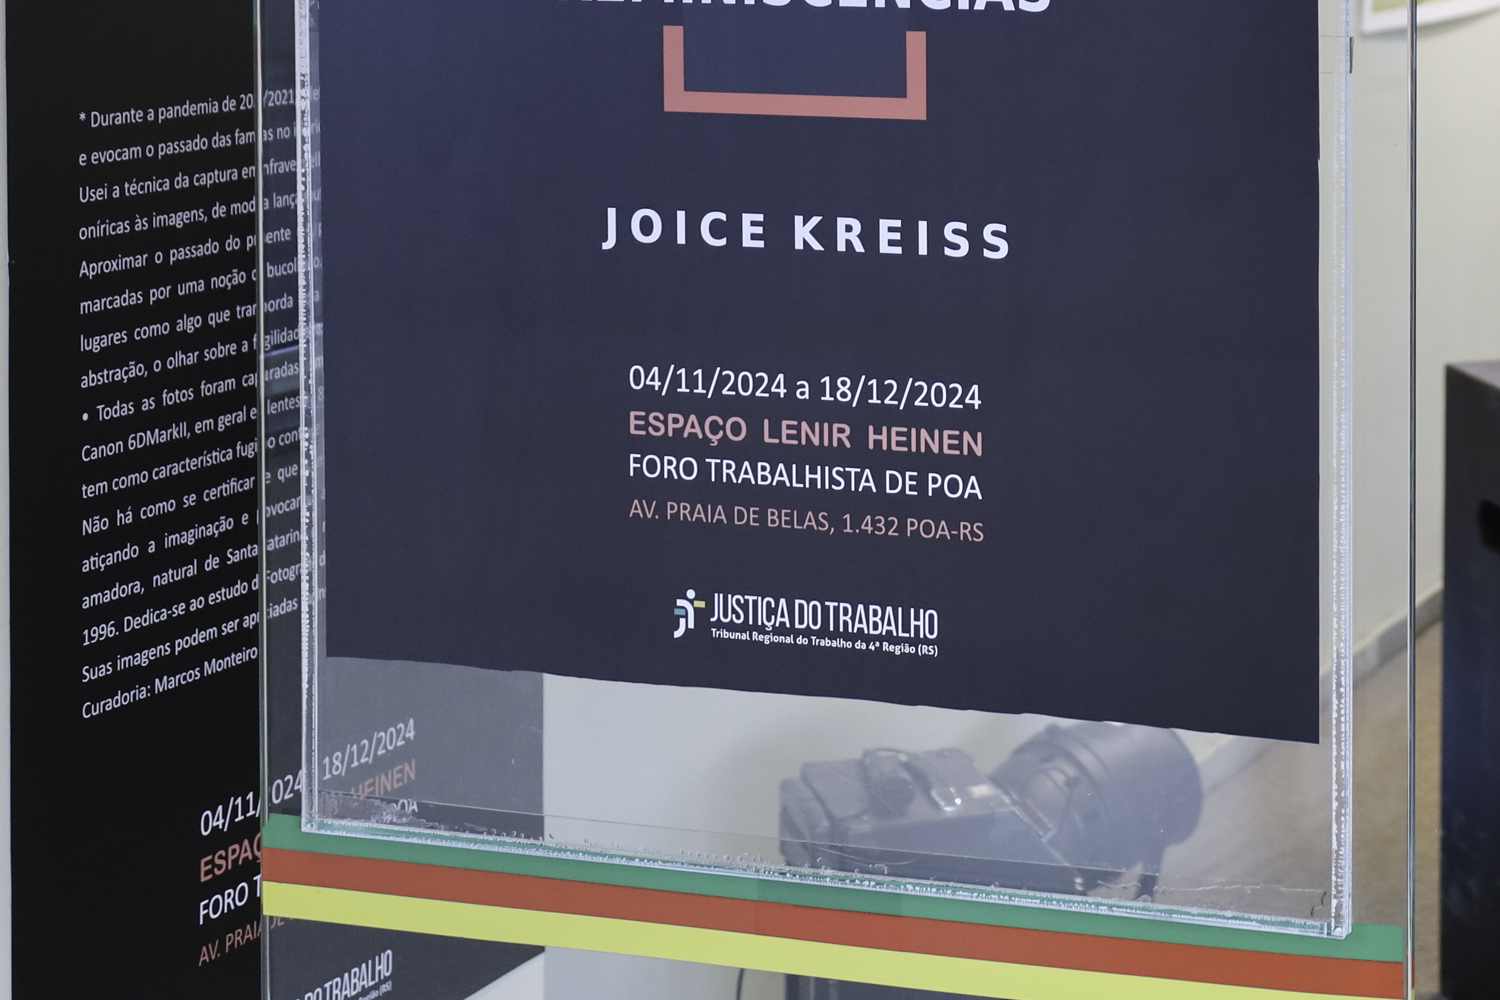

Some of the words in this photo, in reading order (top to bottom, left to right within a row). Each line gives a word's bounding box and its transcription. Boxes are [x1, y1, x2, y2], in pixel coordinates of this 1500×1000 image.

[91, 109, 143, 127] Durante
[147, 109, 154, 121] a
[159, 98, 218, 123] pandemia
[222, 95, 236, 112] de
[79, 154, 86, 165] e
[91, 146, 141, 164] evocam
[146, 145, 154, 157] o
[159, 134, 208, 159] passado
[212, 132, 231, 148] das
[276, 126, 290, 139] no
[80, 184, 107, 202] Usei
[113, 186, 119, 198] a
[124, 177, 169, 196] técnica
[175, 172, 189, 189] da
[194, 169, 237, 187] captura
[79, 220, 130, 239] oníricas
[135, 214, 148, 231] às
[153, 209, 207, 228] imagens,
[212, 202, 226, 218] de
[230, 196, 256, 216] mod
[602, 208, 764, 249] JOICE
[795, 215, 1008, 259] KREISS
[79, 254, 148, 279] Aproximar
[155, 252, 162, 263] o
[170, 238, 219, 265] passado
[226, 235, 240, 251] do
[81, 289, 143, 314] marcadas
[150, 286, 171, 305] por
[178, 280, 204, 295] uma
[211, 269, 246, 289] noção
[81, 331, 127, 352] lugares
[134, 322, 169, 340] como
[176, 314, 202, 333] algo
[208, 310, 230, 327] que
[81, 361, 147, 388] abstração,
[154, 360, 161, 372] o
[167, 353, 198, 369] olhar
[204, 343, 236, 361] sobre
[242, 341, 248, 352] a
[96, 398, 135, 423] Todas
[141, 396, 156, 412] as
[162, 388, 195, 407] fotos
[200, 376, 236, 398] foram
[630, 365, 787, 398] 04/11/2024
[796, 381, 809, 399] a
[821, 375, 981, 410] 18/12/2024
[82, 441, 123, 461] Canon
[195, 419, 213, 433] em
[218, 406, 246, 431] geral
[630, 411, 746, 446] ESPAÇO
[764, 419, 850, 448] LENIR
[869, 425, 982, 456] HEINEN
[82, 481, 107, 498] tem
[112, 471, 148, 490] como
[153, 448, 233, 480] característica
[630, 454, 697, 480] FORO
[706, 459, 876, 492] TRABALHISTA
[886, 470, 917, 495] DE
[928, 473, 982, 499] POA
[83, 516, 108, 535] Não
[117, 506, 132, 526] há
[141, 500, 175, 519] como
[183, 494, 196, 507] se
[204, 477, 255, 501] certificar
[277, 463, 299, 483] que
[630, 499, 658, 519] AV.
[668, 502, 727, 523] PRAIA
[735, 506, 759, 526] DE
[768, 509, 834, 535] BELAS,
[843, 514, 898, 535] 1.432
[908, 518, 983, 541] POA-RS
[82, 544, 139, 572] atiçando
[148, 541, 155, 553] a
[165, 516, 233, 548] imaginação
[242, 513, 248, 524] e
[82, 581, 144, 609] amadora,
[153, 561, 197, 587] natural
[205, 554, 219, 571] de
[226, 543, 258, 565] Santa
[83, 621, 118, 645] 1996.
[124, 603, 185, 632] Dedica-se
[190, 597, 204, 611] ao
[209, 581, 248, 604] estudo
[710, 593, 790, 630] JUSTIÇA
[795, 599, 821, 629] DO
[825, 601, 937, 639] TRABALHO
[82, 662, 112, 682] Suas
[118, 643, 170, 670] imagens
[175, 627, 217, 654] podem
[222, 619, 239, 635] ser
[711, 628, 750, 640] Tribunal
[753, 632, 794, 644] Regional
[796, 635, 808, 644] do
[811, 636, 852, 648] Trabalho
[855, 640, 866, 649] da
[869, 641, 879, 651] 4ª
[883, 642, 915, 655] Região
[918, 644, 937, 657] (RS)
[83, 685, 150, 718] Curadoria:
[155, 668, 200, 693] Marcos
[204, 647, 257, 676] Monteiro
[200, 770, 303, 837] 04/11/024
[322, 718, 416, 781] 18/12/2024
[200, 832, 262, 883] ESPAÇ
[199, 881, 250, 926] FORO
[198, 945, 221, 967] AV.
